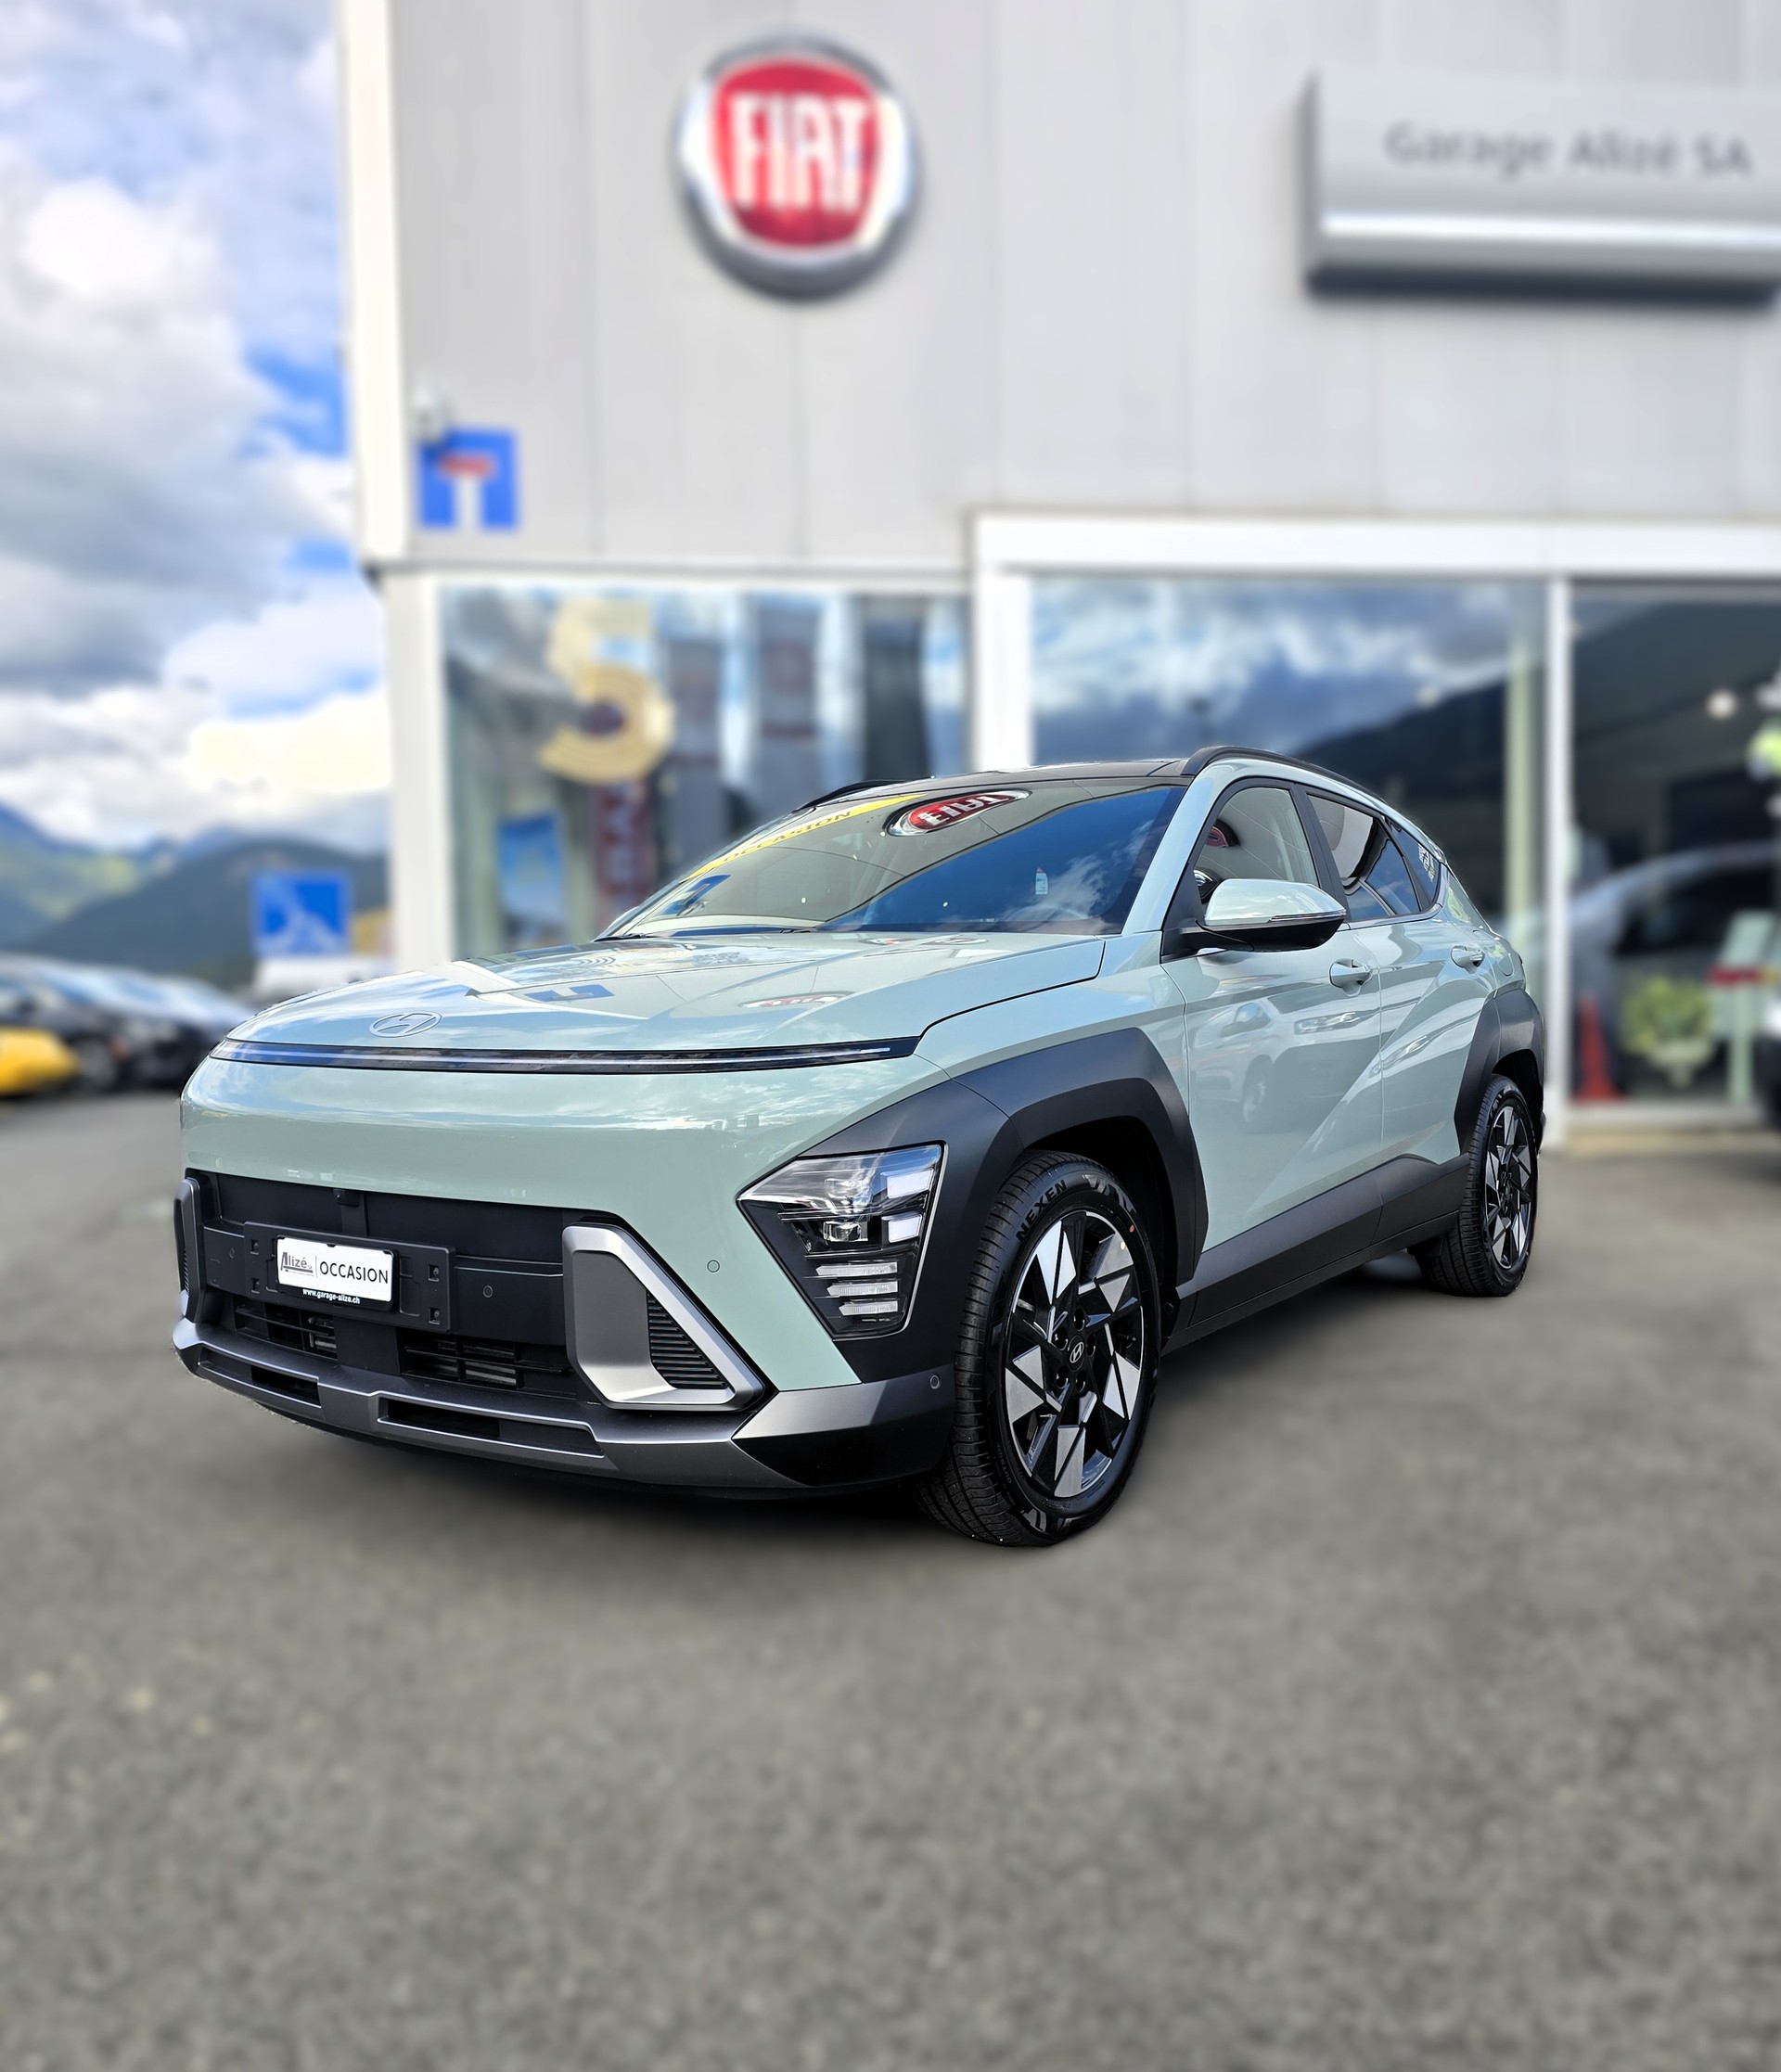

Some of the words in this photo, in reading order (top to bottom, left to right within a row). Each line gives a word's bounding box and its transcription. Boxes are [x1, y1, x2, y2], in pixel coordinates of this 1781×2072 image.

[731, 94, 868, 210] FIAT
[1385, 122, 1554, 180] Garage
[1568, 129, 1679, 174] Alizé
[1693, 135, 1754, 176] SA
[723, 811, 852, 863] OCCASION
[1015, 1179, 1068, 1242] NEXEN
[280, 1252, 308, 1272] Alizé
[319, 1260, 389, 1285] OCCASION
[302, 1288, 361, 1305] www.garage-alize.ch
